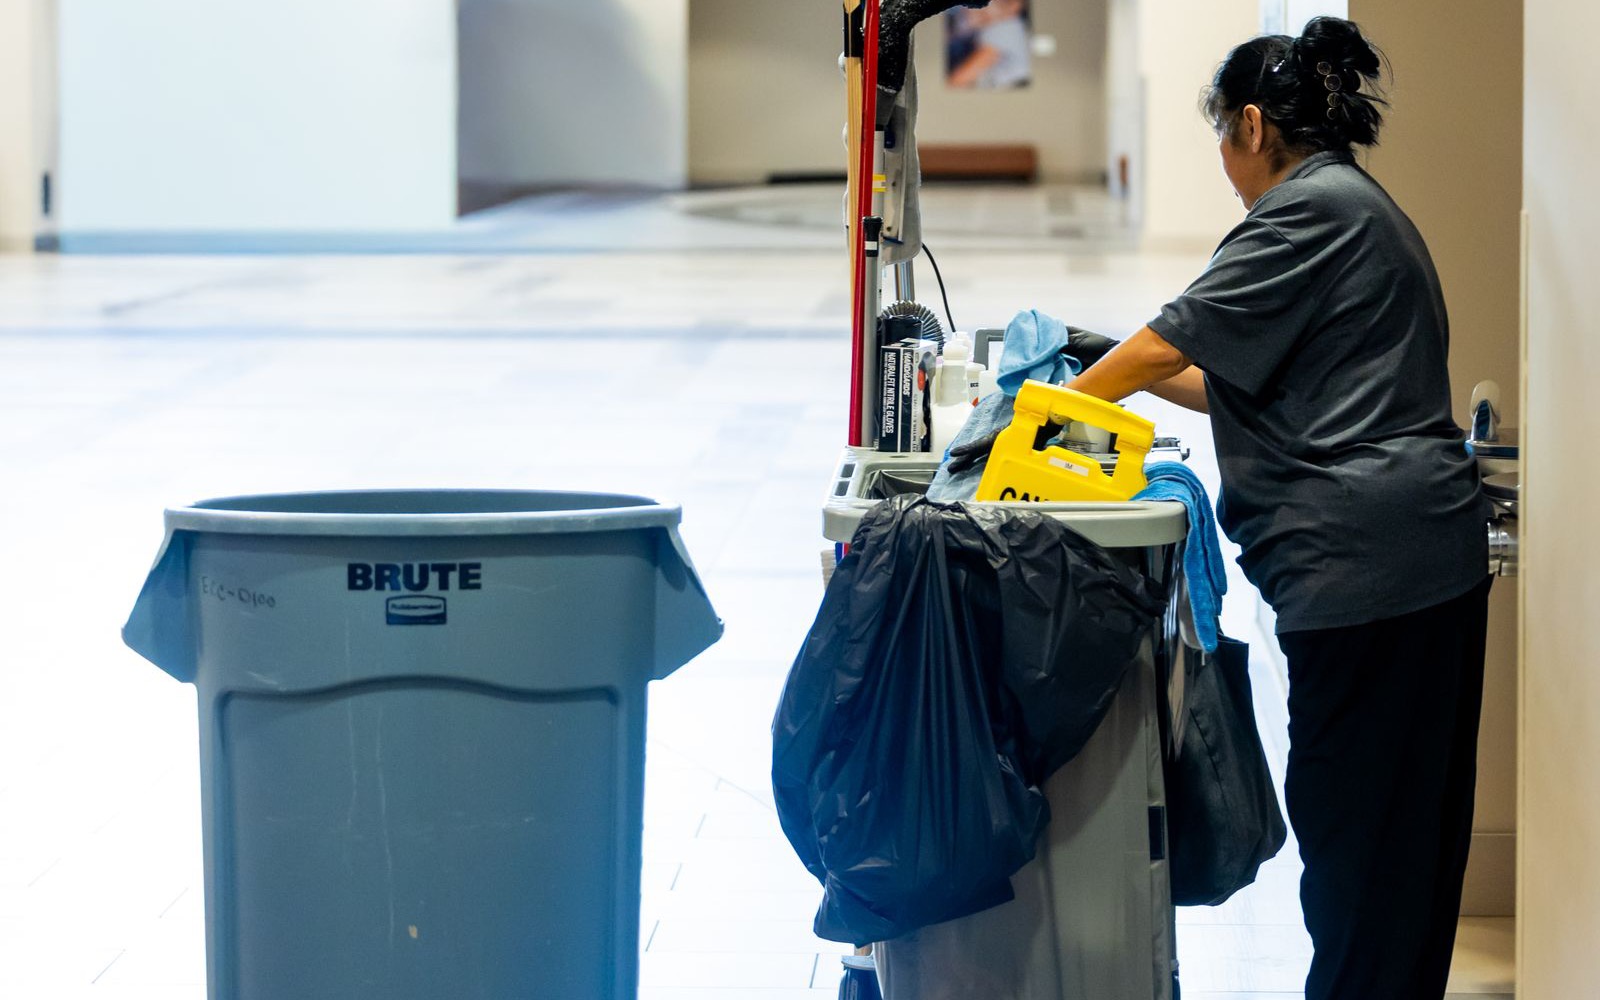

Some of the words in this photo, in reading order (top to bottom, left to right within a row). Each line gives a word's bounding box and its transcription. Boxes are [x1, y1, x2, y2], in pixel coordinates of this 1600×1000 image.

[886, 387, 895, 410] NITRILE
[885, 410, 894, 434] GLOVES
[347, 562, 482, 591] BRUTE
